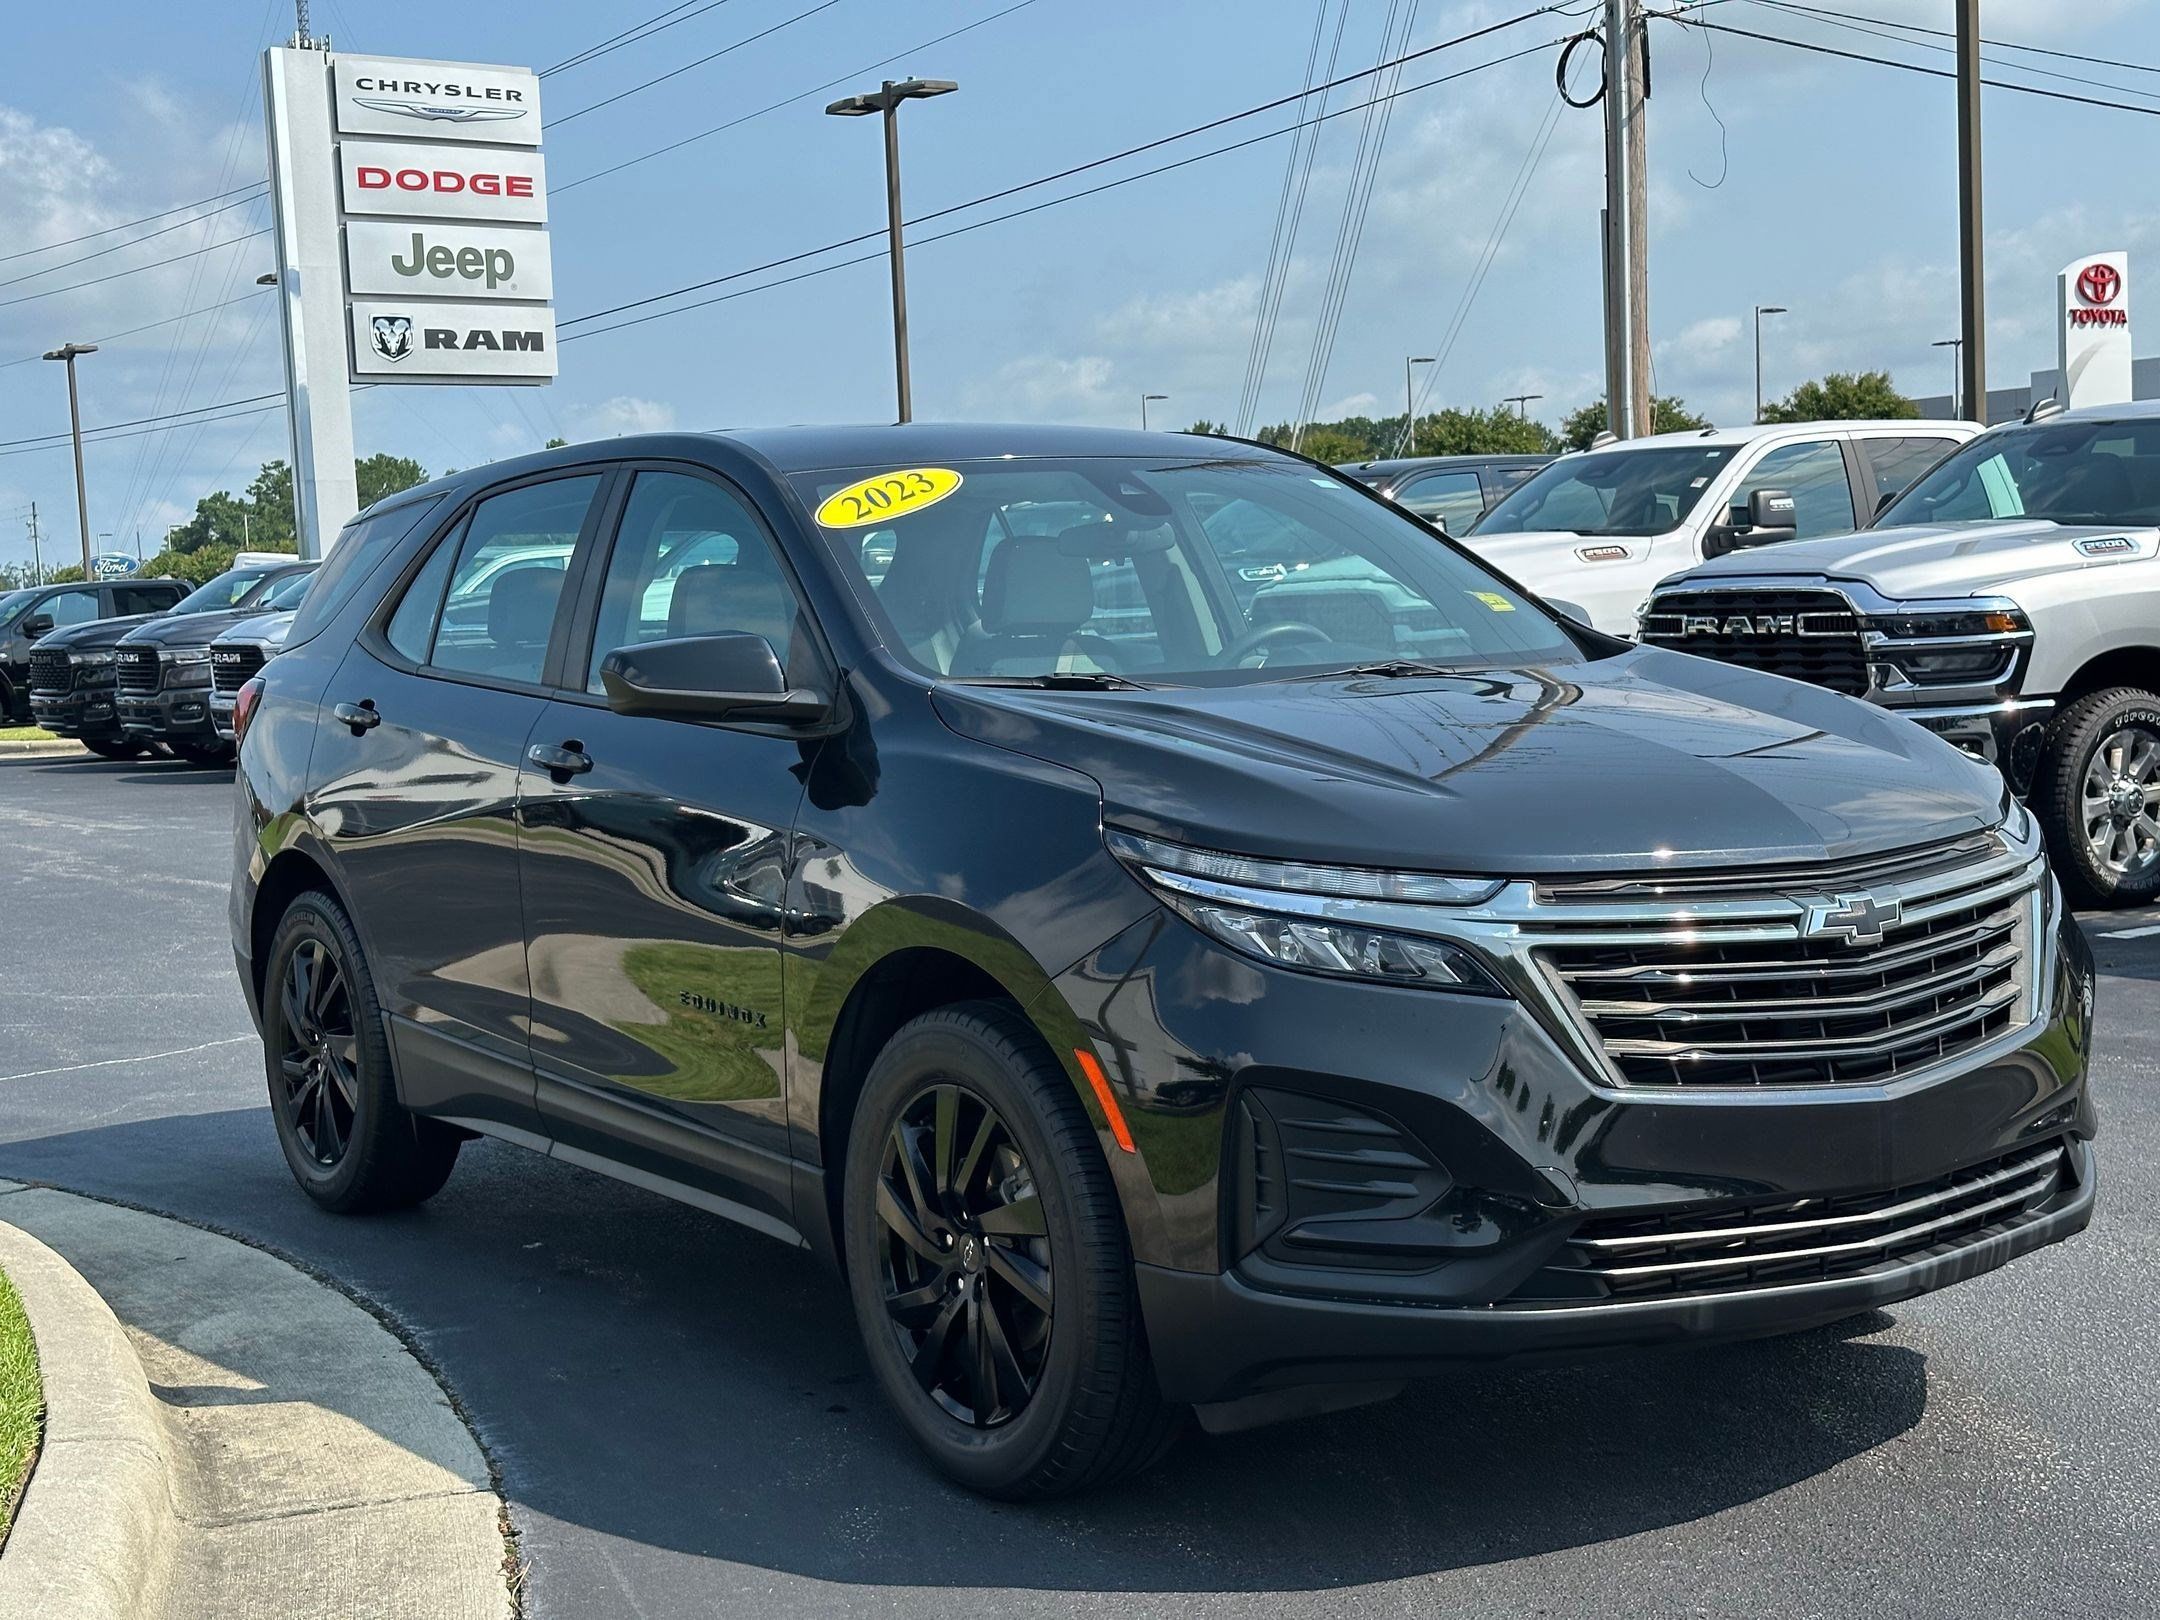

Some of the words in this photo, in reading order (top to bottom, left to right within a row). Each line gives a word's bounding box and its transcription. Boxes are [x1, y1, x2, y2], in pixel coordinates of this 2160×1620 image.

[355, 78, 522, 102] CHRYSLER
[357, 166, 534, 198] DODGE
[391, 233, 515, 289] Jeep
[2067, 308, 2128, 325] TOYOTA
[424, 328, 545, 352] RAM
[841, 472, 935, 520] 2023
[94, 558, 129, 573] Ford
[1687, 615, 1794, 635] RAM
[117, 653, 139, 663] RAM
[214, 653, 241, 663] RAM
[680, 989, 767, 1029] EQUINOX
